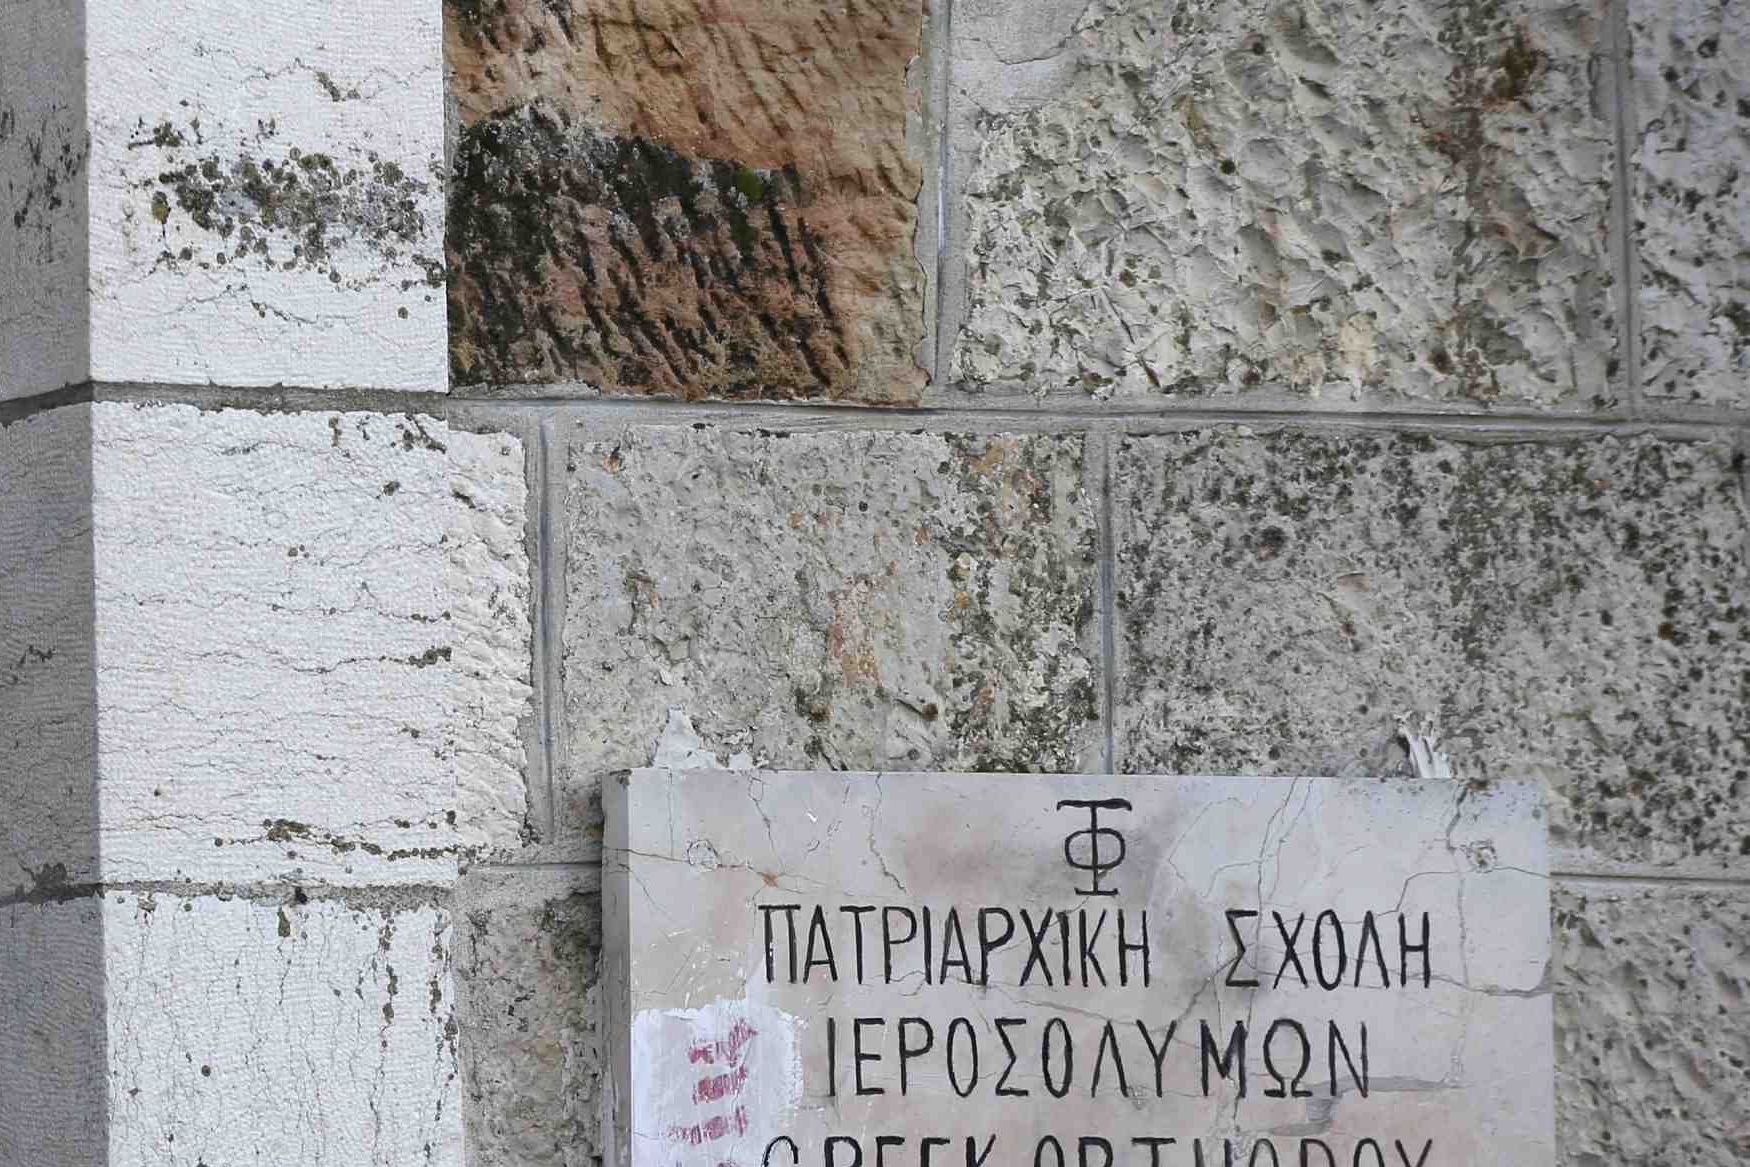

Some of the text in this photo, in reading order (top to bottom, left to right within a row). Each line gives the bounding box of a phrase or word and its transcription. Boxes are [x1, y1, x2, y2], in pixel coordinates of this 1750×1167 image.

[758, 904, 1432, 989] ΠΑΤΡΙΑΡΧΙΚΗ ΣΧΟΛΗ
[827, 1016, 1370, 1099] ΙΕΡΟΣΟΛΥΜΩΝ
